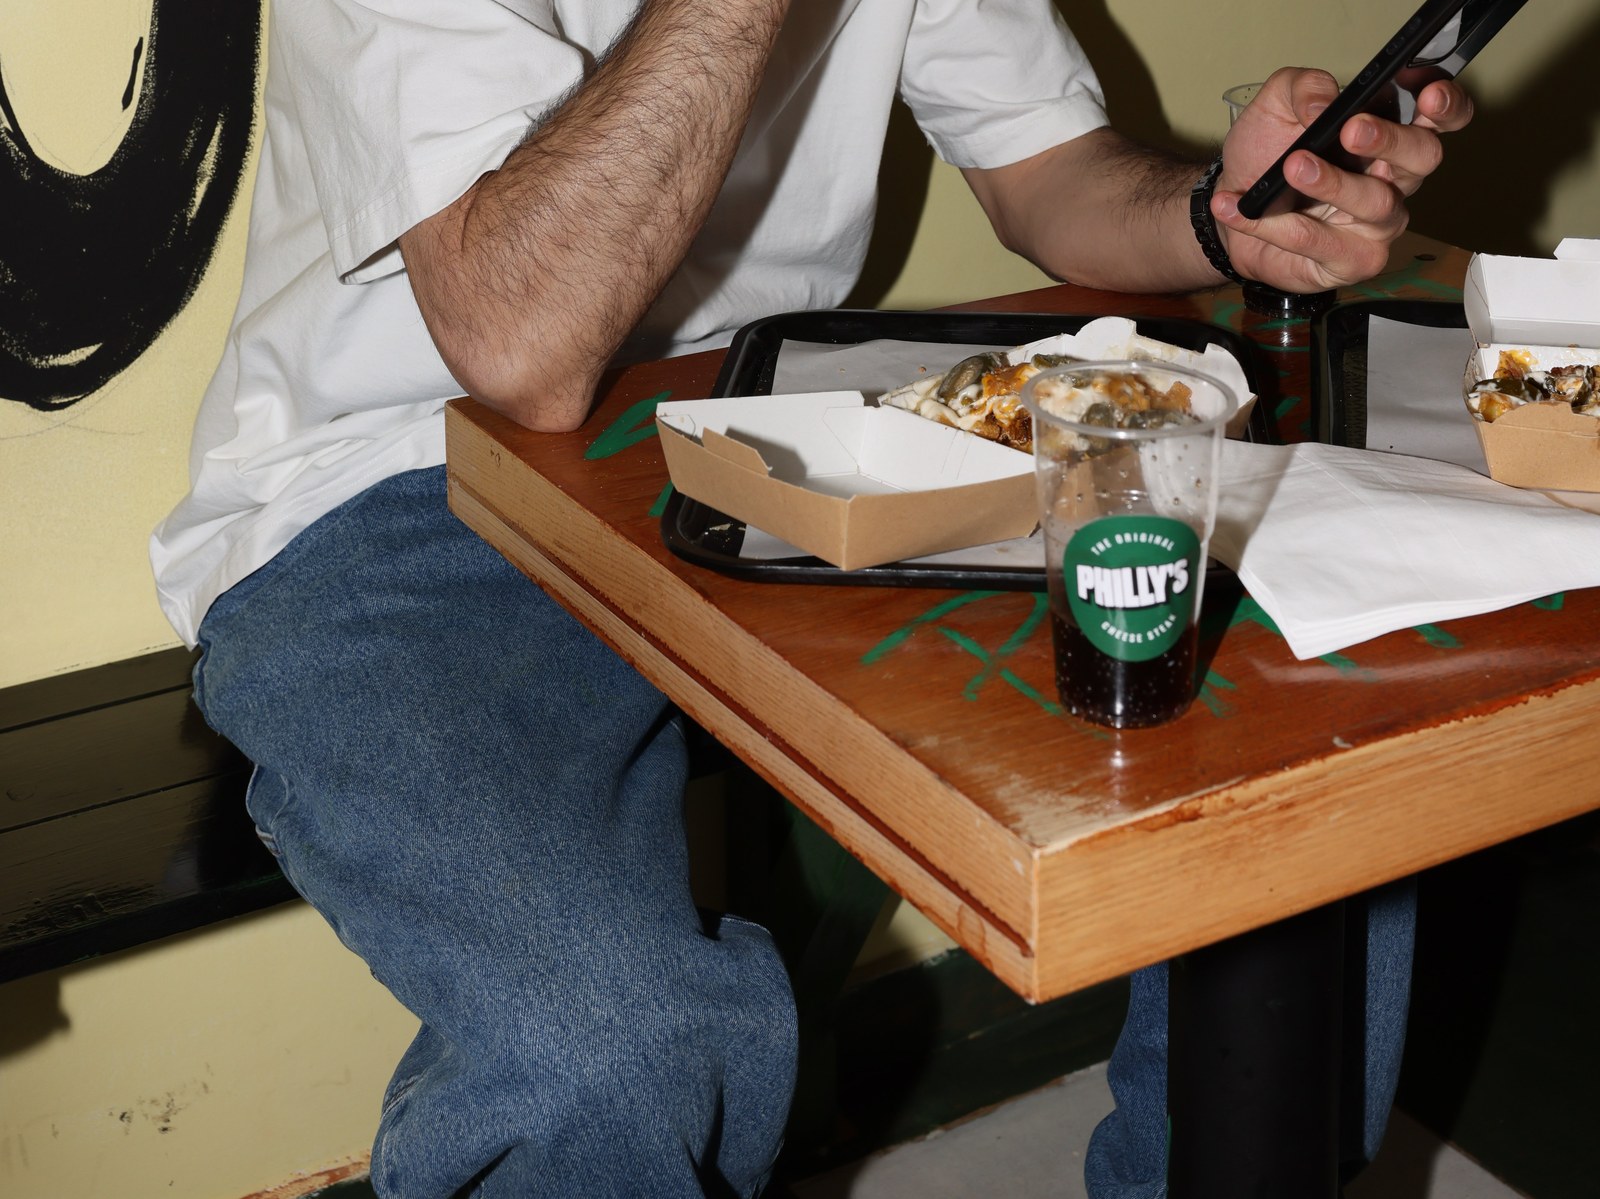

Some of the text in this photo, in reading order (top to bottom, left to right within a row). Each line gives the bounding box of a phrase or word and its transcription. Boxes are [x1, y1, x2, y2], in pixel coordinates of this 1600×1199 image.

[1090, 532, 1175, 556] THE ORIGINAL
[1076, 558, 1189, 608] PHILLY'S
[1101, 621, 1143, 643] CHEESE
